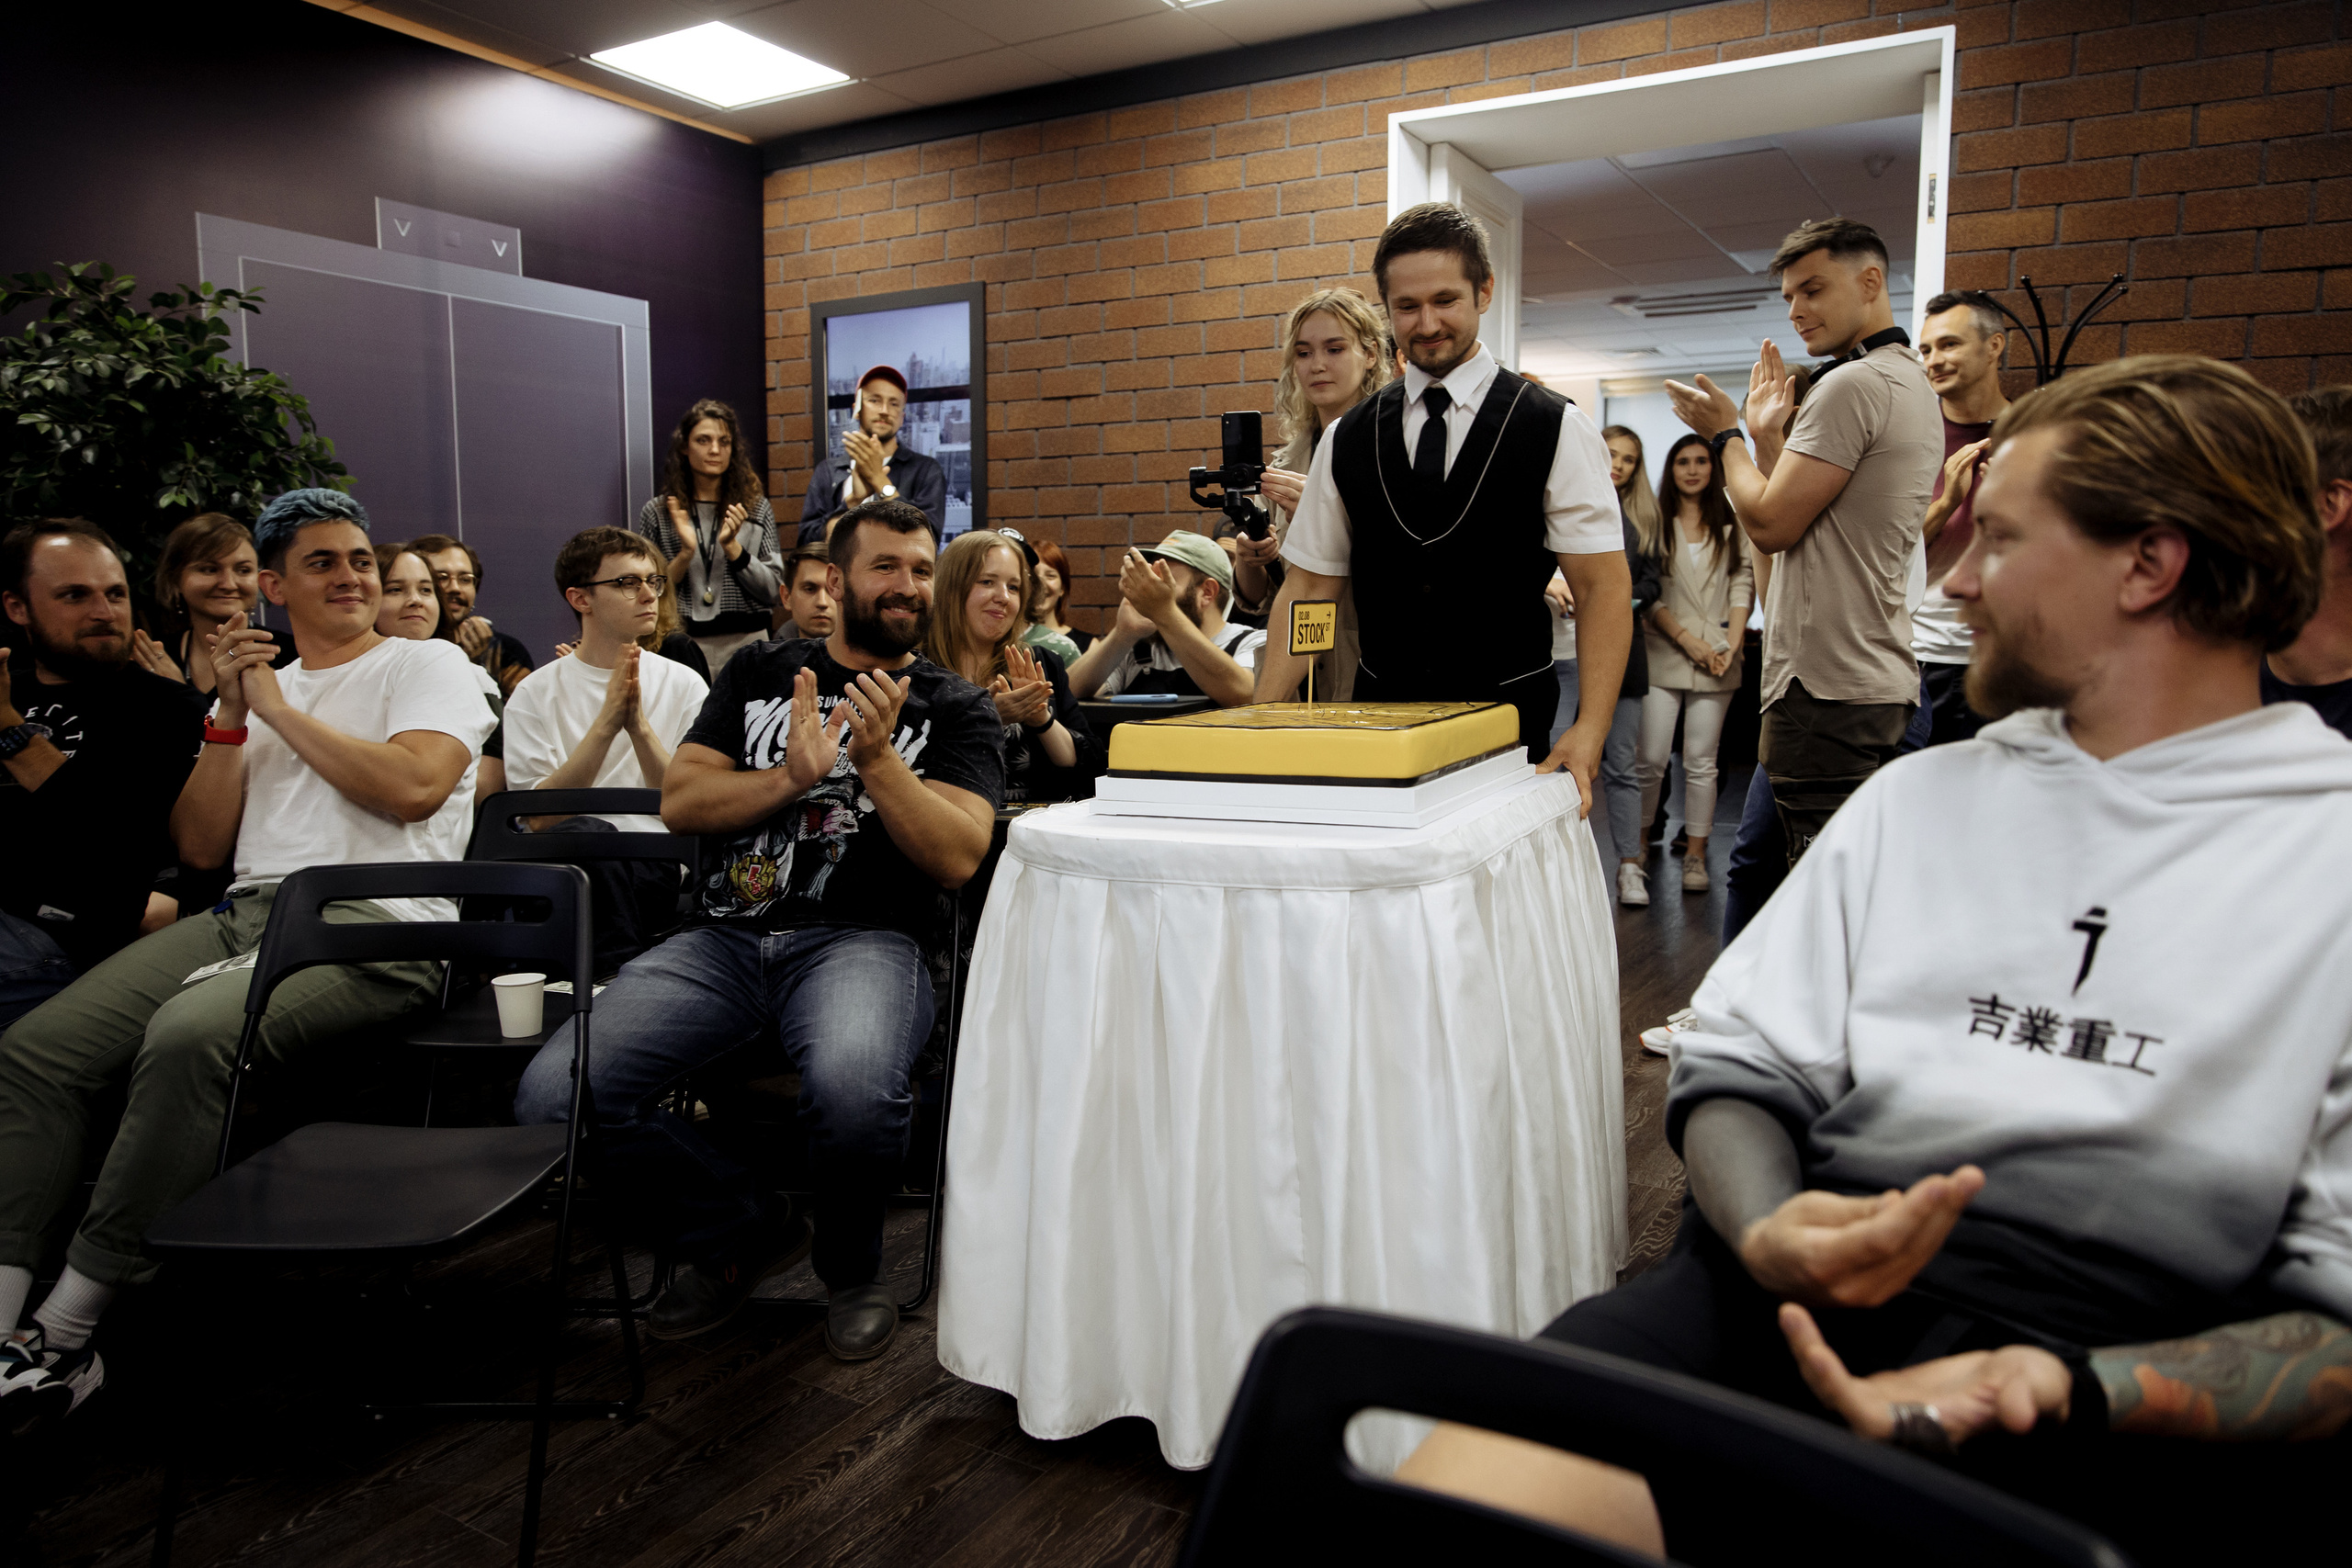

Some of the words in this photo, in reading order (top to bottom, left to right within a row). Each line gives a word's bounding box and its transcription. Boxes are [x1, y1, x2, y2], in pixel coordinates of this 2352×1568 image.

[1297, 623, 1326, 645] STOCK
[1968, 993, 2164, 1077] 吉業重工
